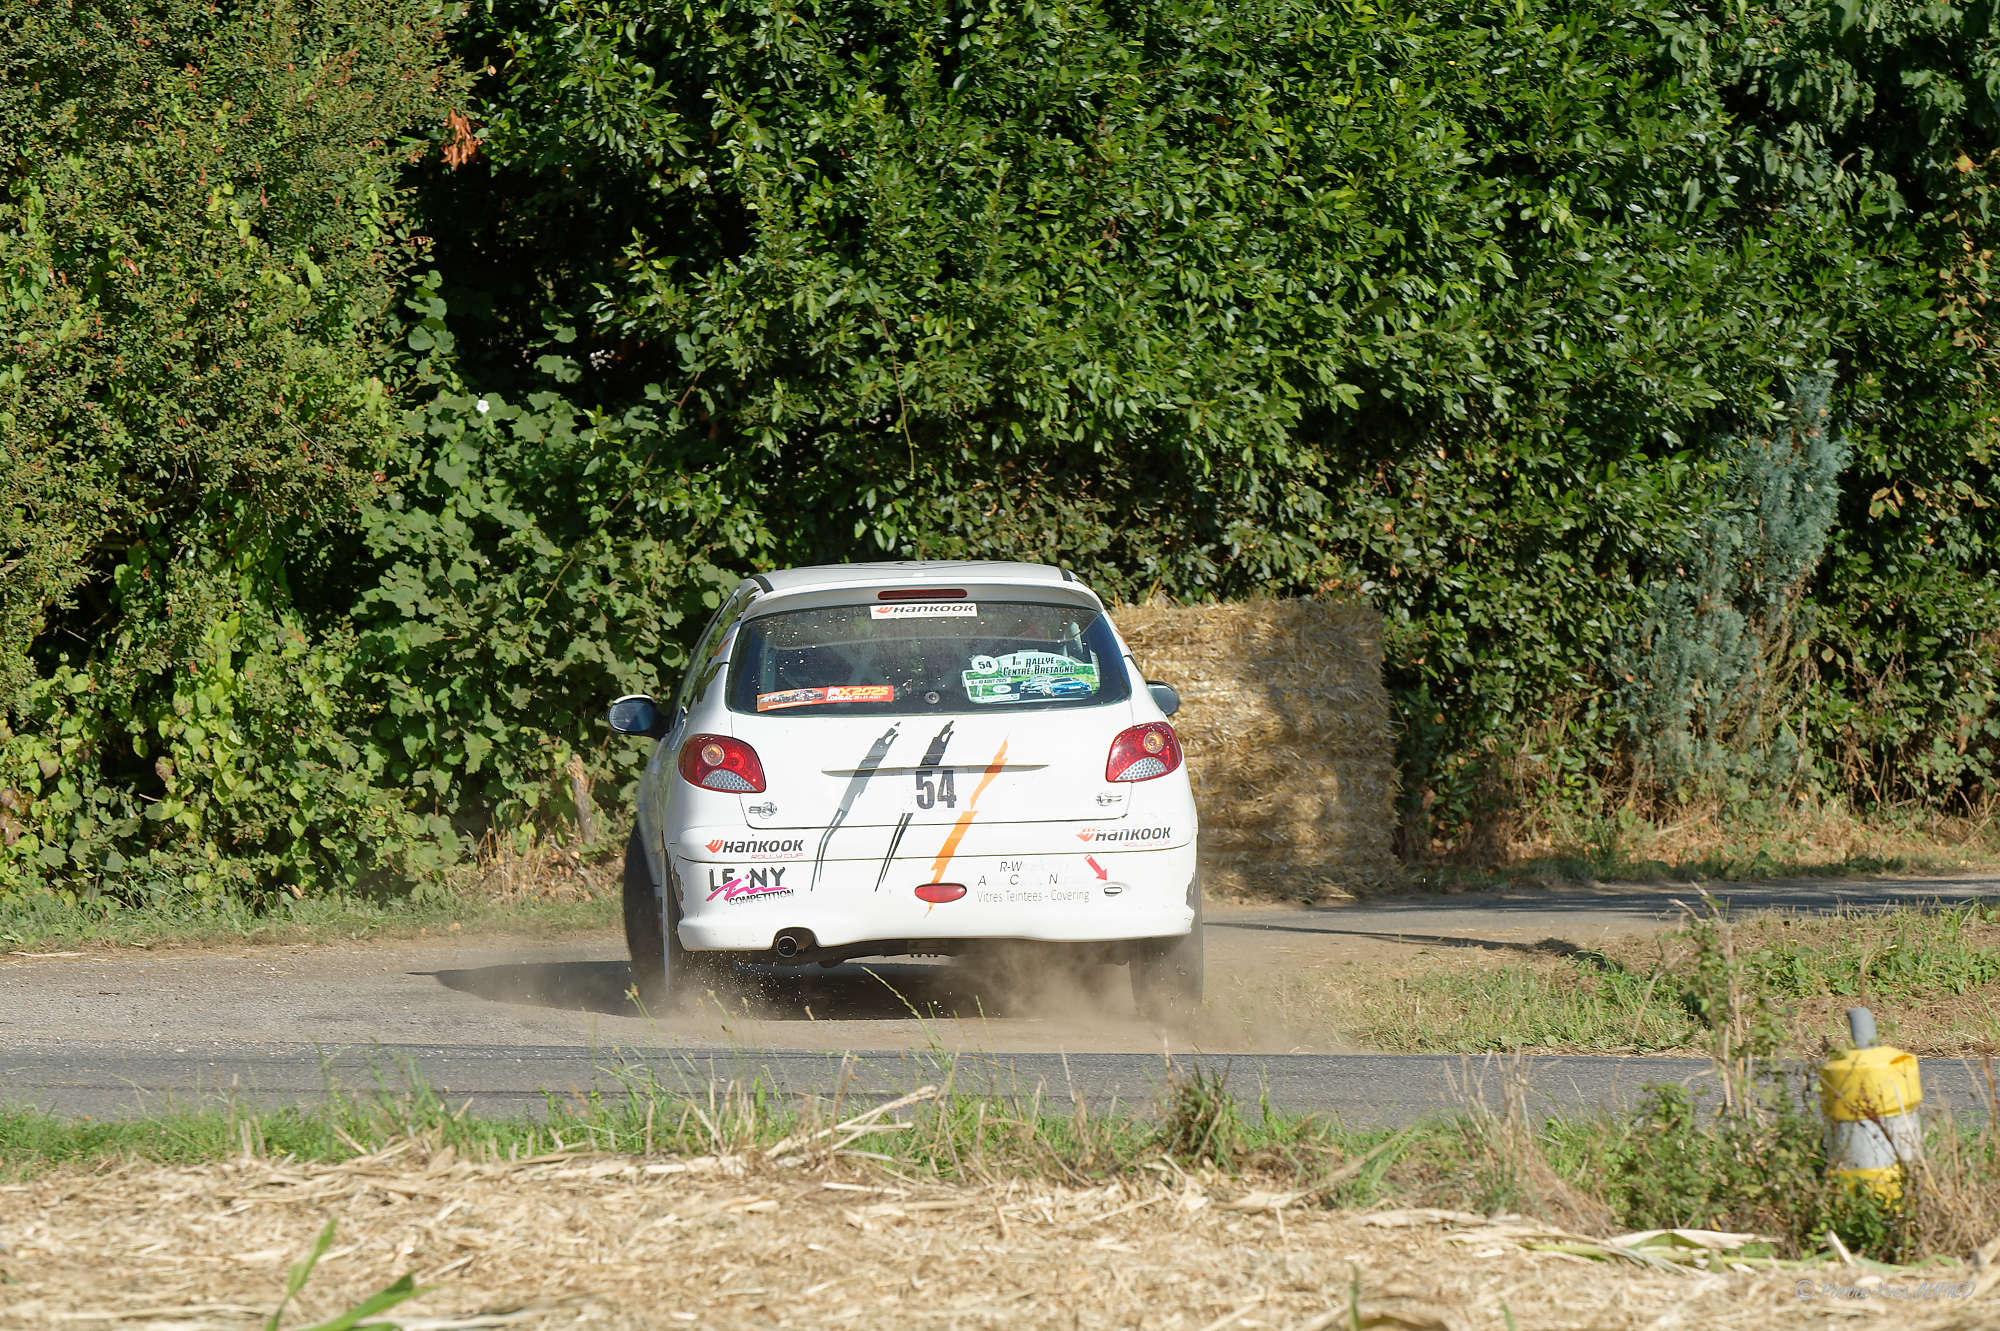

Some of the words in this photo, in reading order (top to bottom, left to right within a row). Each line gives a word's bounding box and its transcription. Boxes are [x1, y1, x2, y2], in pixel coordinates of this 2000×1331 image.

[977, 660, 993, 670] 54
[1025, 656, 1056, 668] RALLYE
[915, 769, 957, 810] 54
